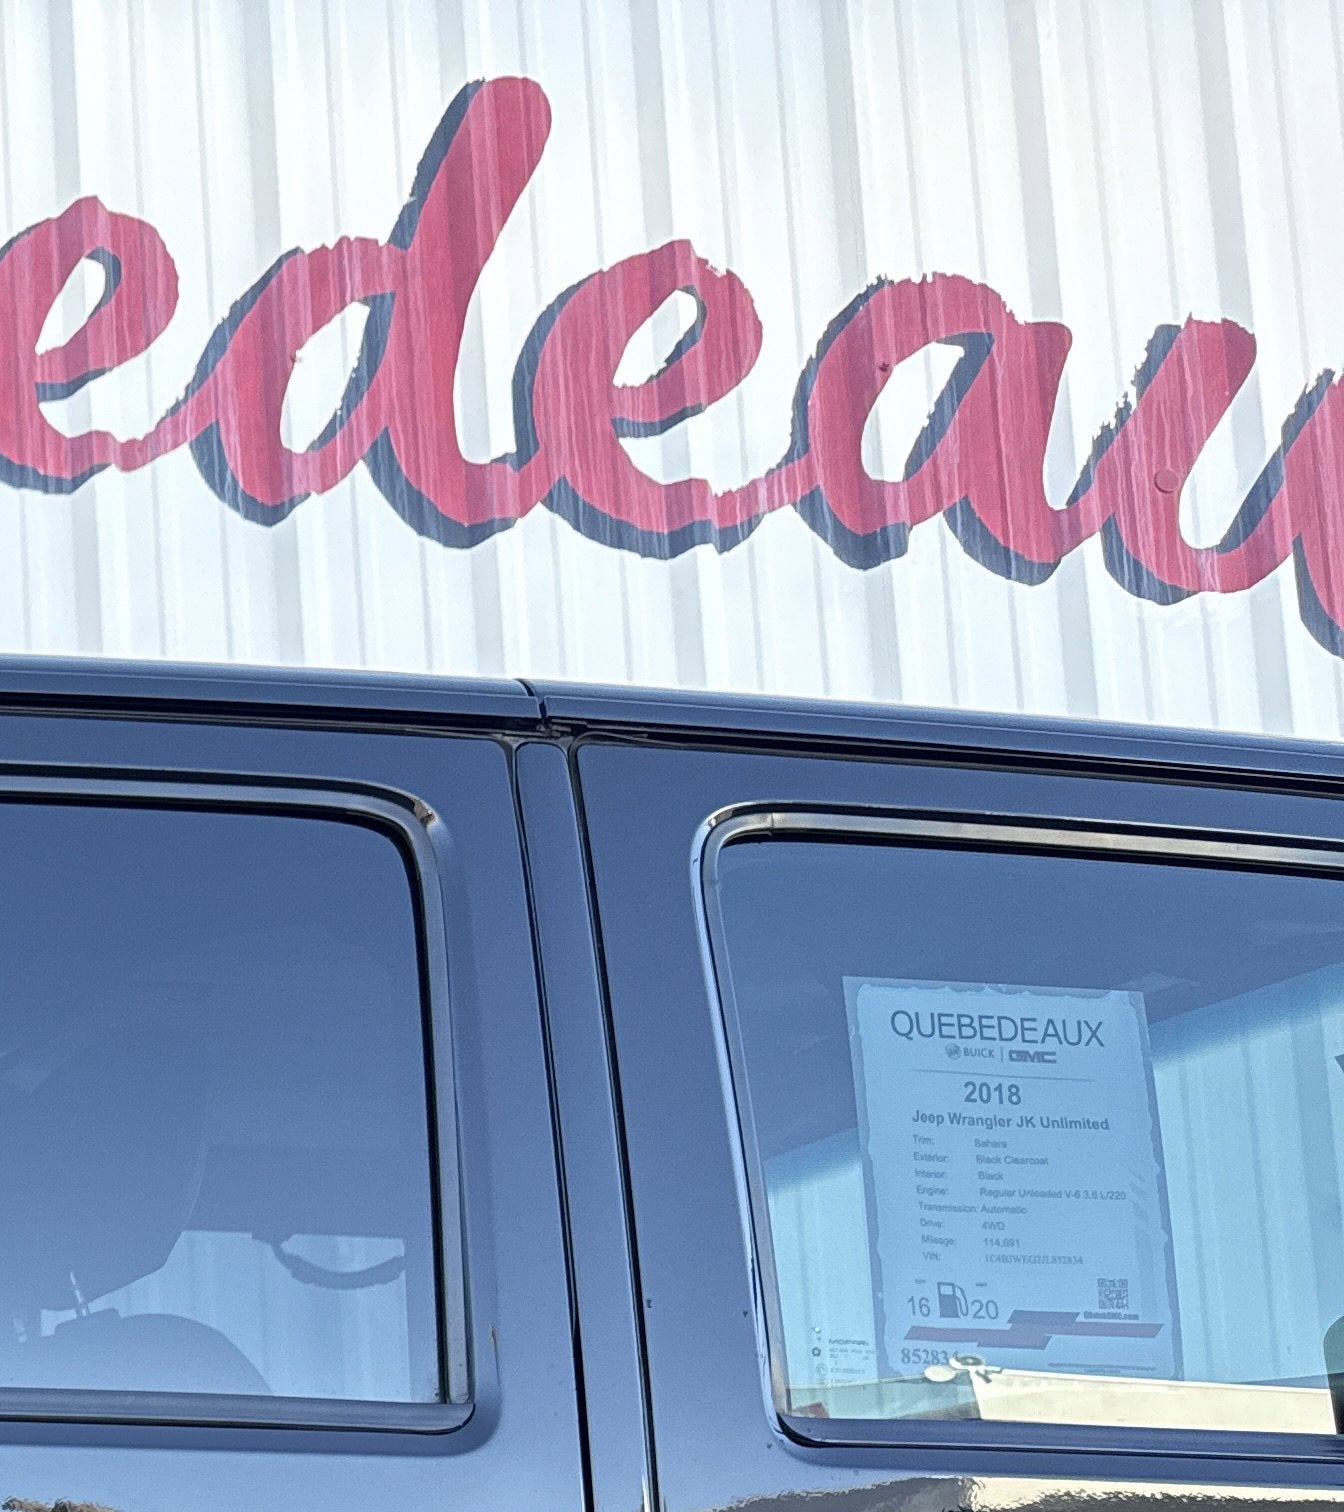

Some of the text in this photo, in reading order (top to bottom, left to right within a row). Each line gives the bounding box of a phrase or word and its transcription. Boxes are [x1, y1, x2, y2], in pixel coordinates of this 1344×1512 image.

[890, 1009, 1105, 1047] QUEBEDEAUX
[963, 1047, 1057, 1064] BUICK GMC
[963, 1081, 1022, 1105] 2018
[912, 1110, 1110, 1130] Jeep Wrangler JK Unlimited
[913, 1135, 1007, 1148] Trim: Sahara
[913, 1152, 1049, 1166] Exterior: Black Clearcoat
[915, 1168, 1004, 1181] Interior: Black
[916, 1185, 949, 1196] Engine:
[980, 1187, 1016, 1199] Regular
[1019, 1189, 1062, 1199] Unleaded
[918, 1202, 1027, 1214] Transmission: Automatic
[981, 1222, 1005, 1231] 4WD
[922, 1235, 956, 1246] Mileage:
[907, 1296, 999, 1320] 16 20
